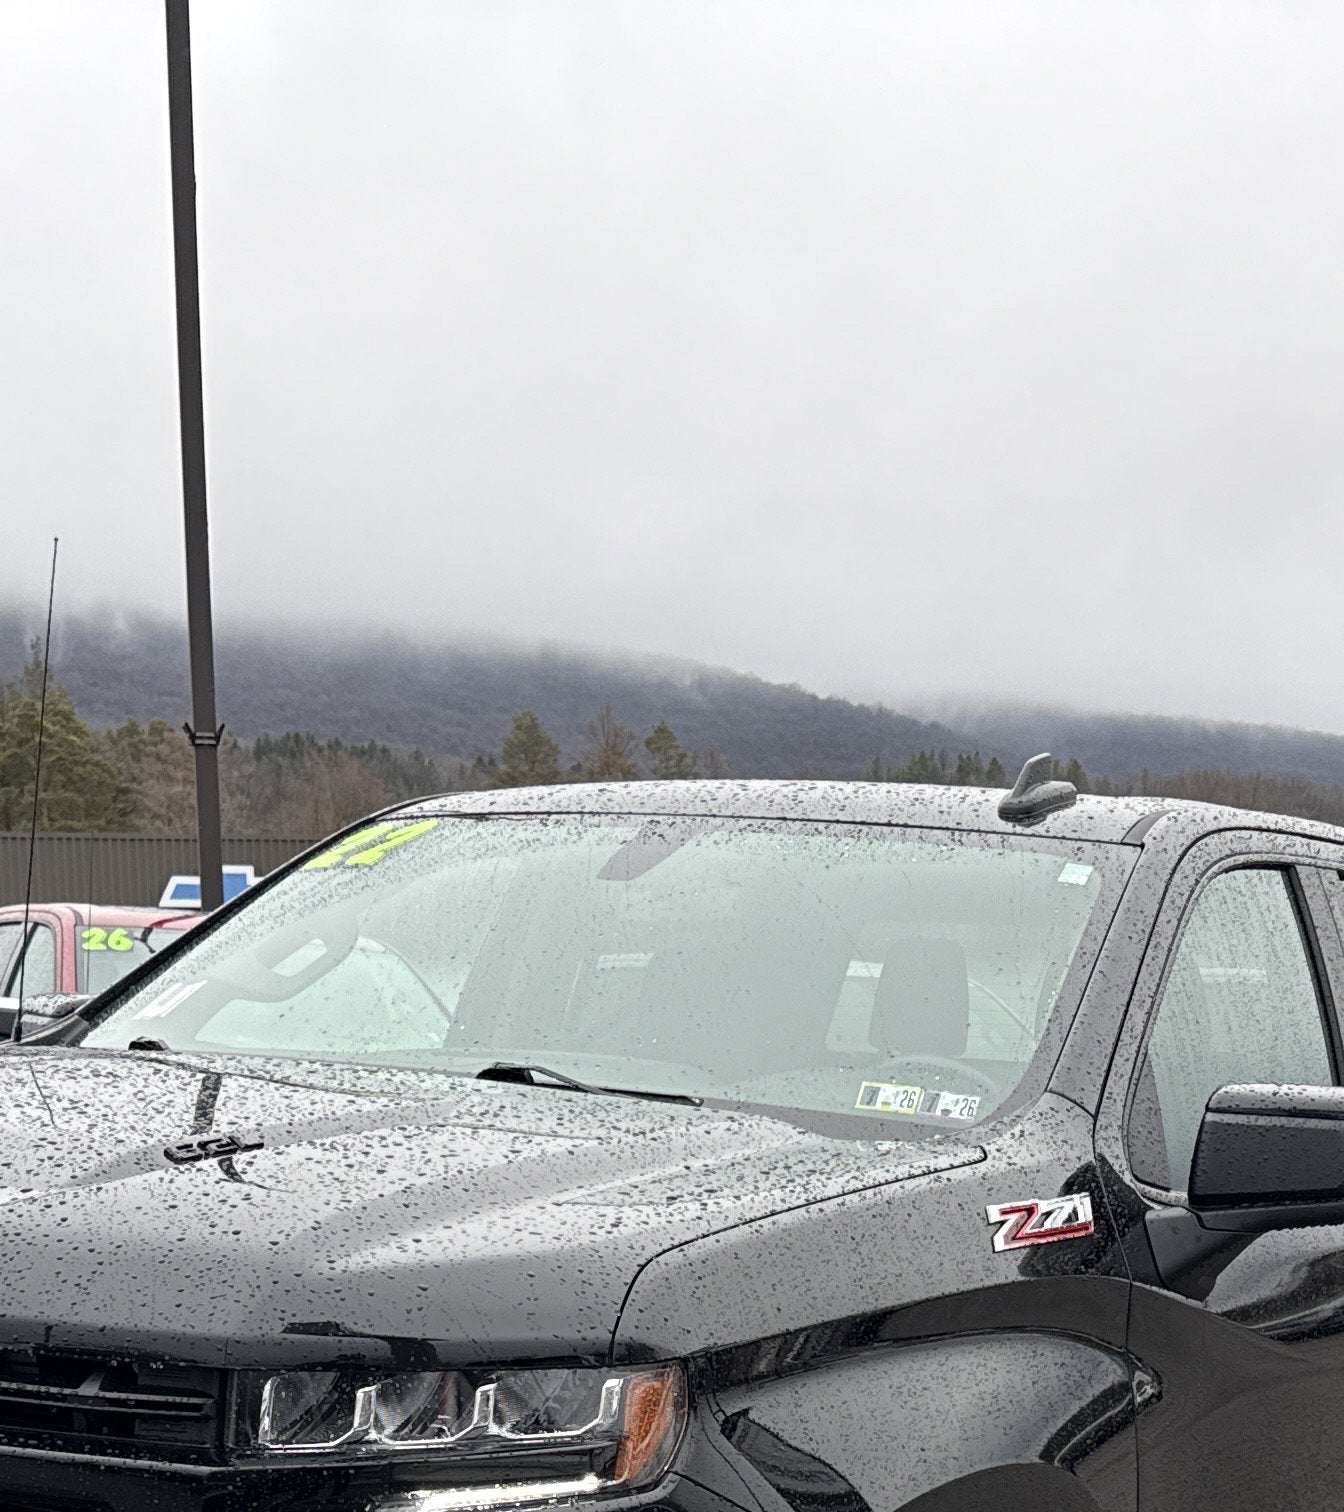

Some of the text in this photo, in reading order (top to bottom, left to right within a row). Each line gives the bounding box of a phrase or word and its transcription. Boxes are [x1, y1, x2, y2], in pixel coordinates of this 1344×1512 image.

[81, 927, 133, 952] 26
[899, 1089, 917, 1109] 26
[959, 1097, 977, 1117] 26
[985, 1191, 1095, 1254] Z71
